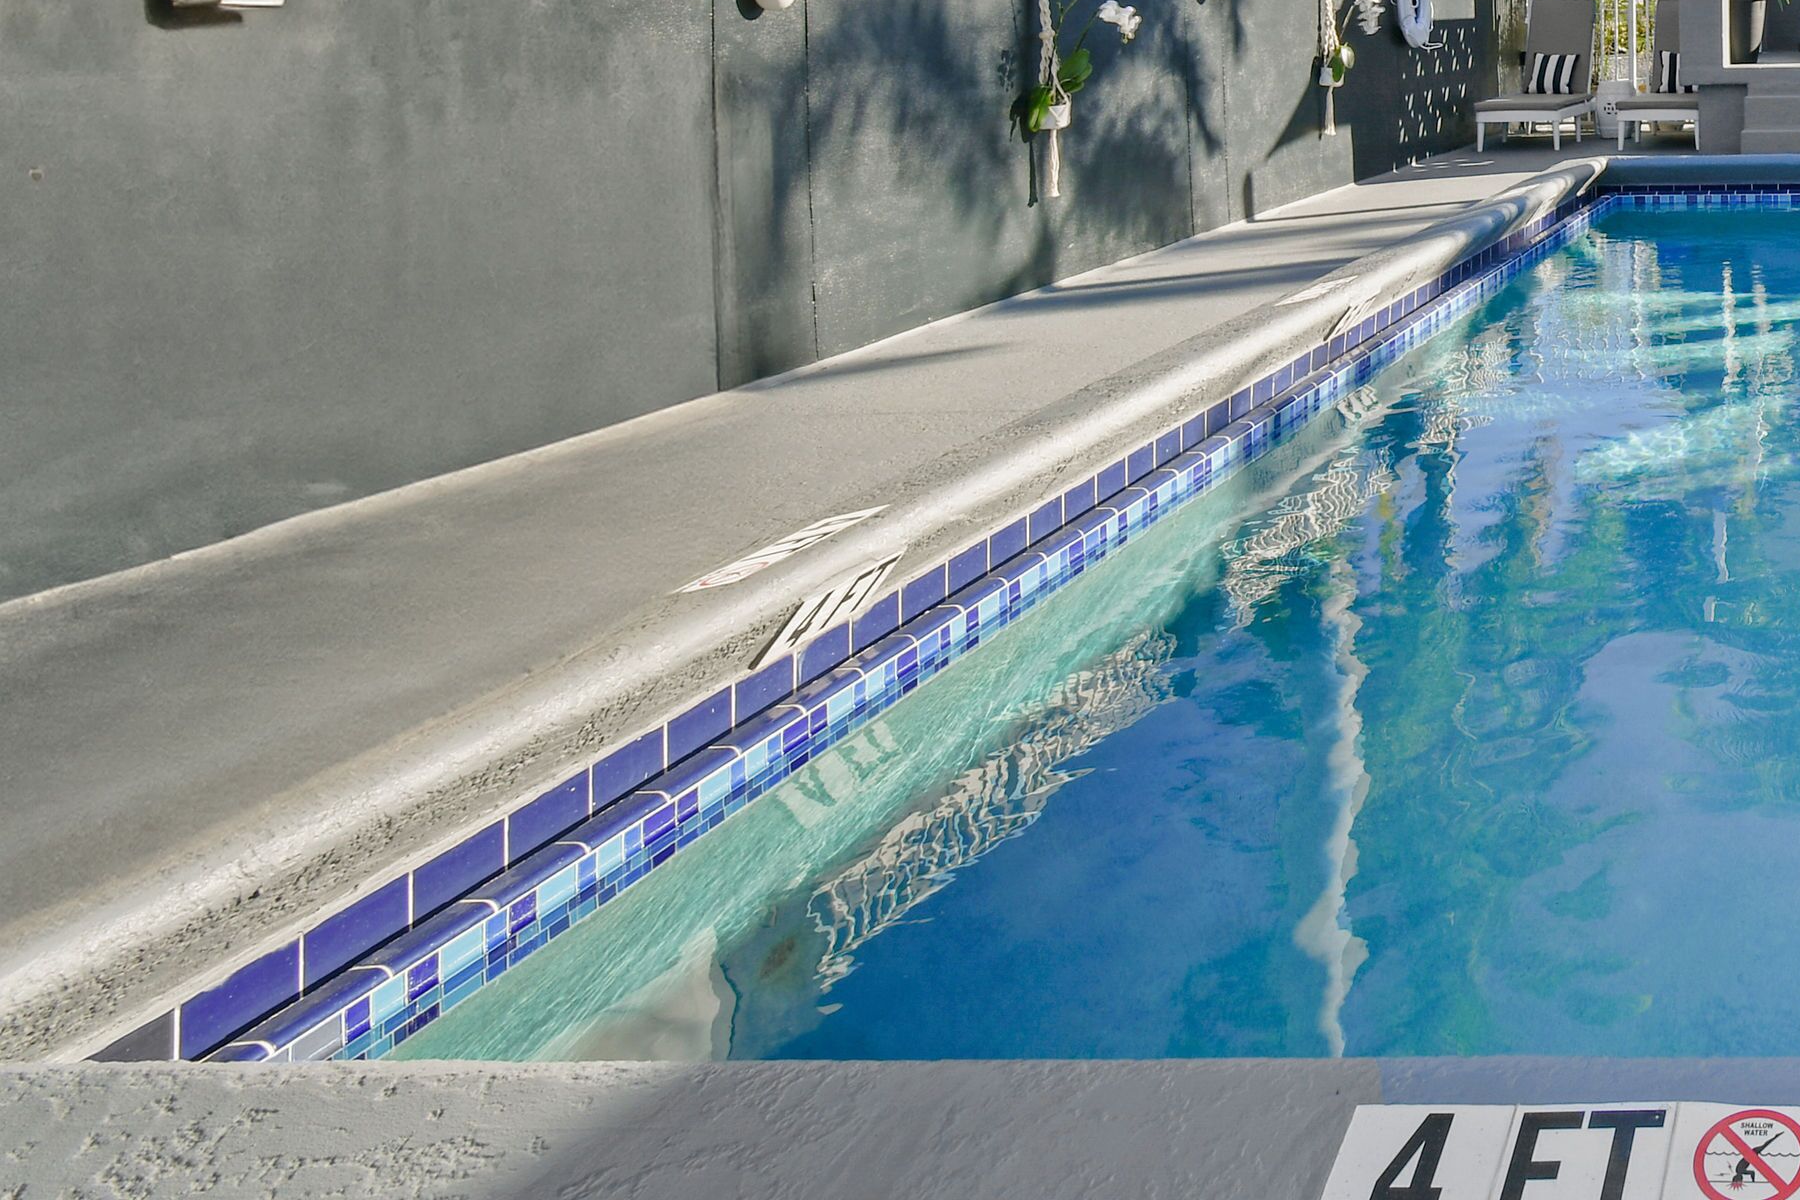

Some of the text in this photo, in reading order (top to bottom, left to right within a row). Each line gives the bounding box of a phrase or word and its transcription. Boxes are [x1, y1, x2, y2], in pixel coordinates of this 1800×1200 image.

[786, 554, 902, 647] 4 FT
[1369, 1110, 1667, 1200] 4 FT
